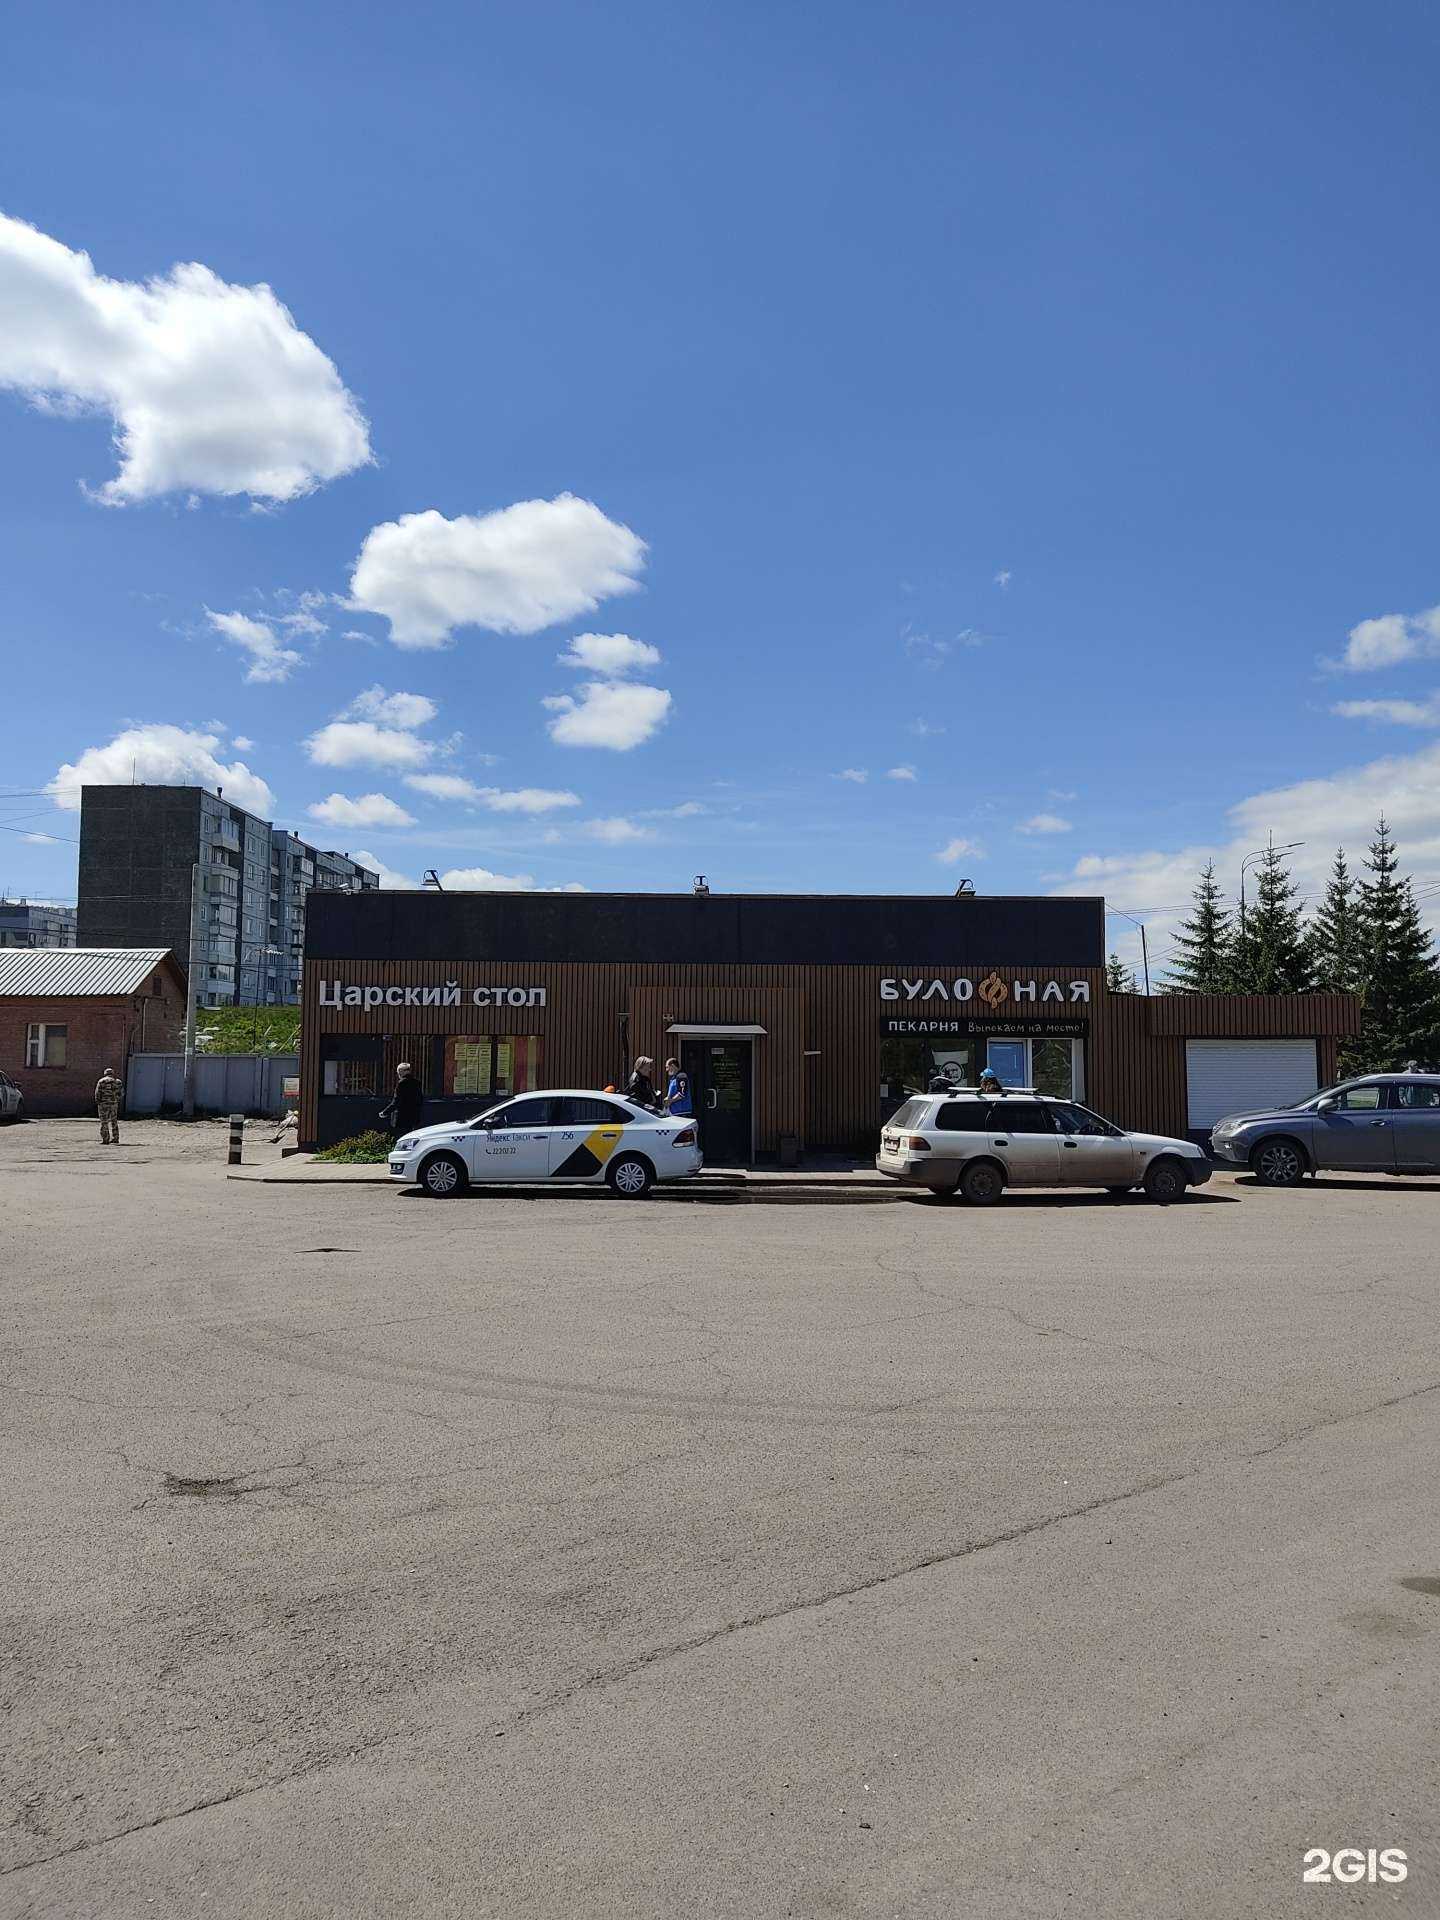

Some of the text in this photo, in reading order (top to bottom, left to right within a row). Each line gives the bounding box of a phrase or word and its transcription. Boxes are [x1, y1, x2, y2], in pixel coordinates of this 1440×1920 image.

[319, 980, 547, 1012] Царский стол
[888, 1021, 1084, 1033] ПЕКАРНЯ Выпекаем на месте!
[561, 1131, 574, 1140] 256
